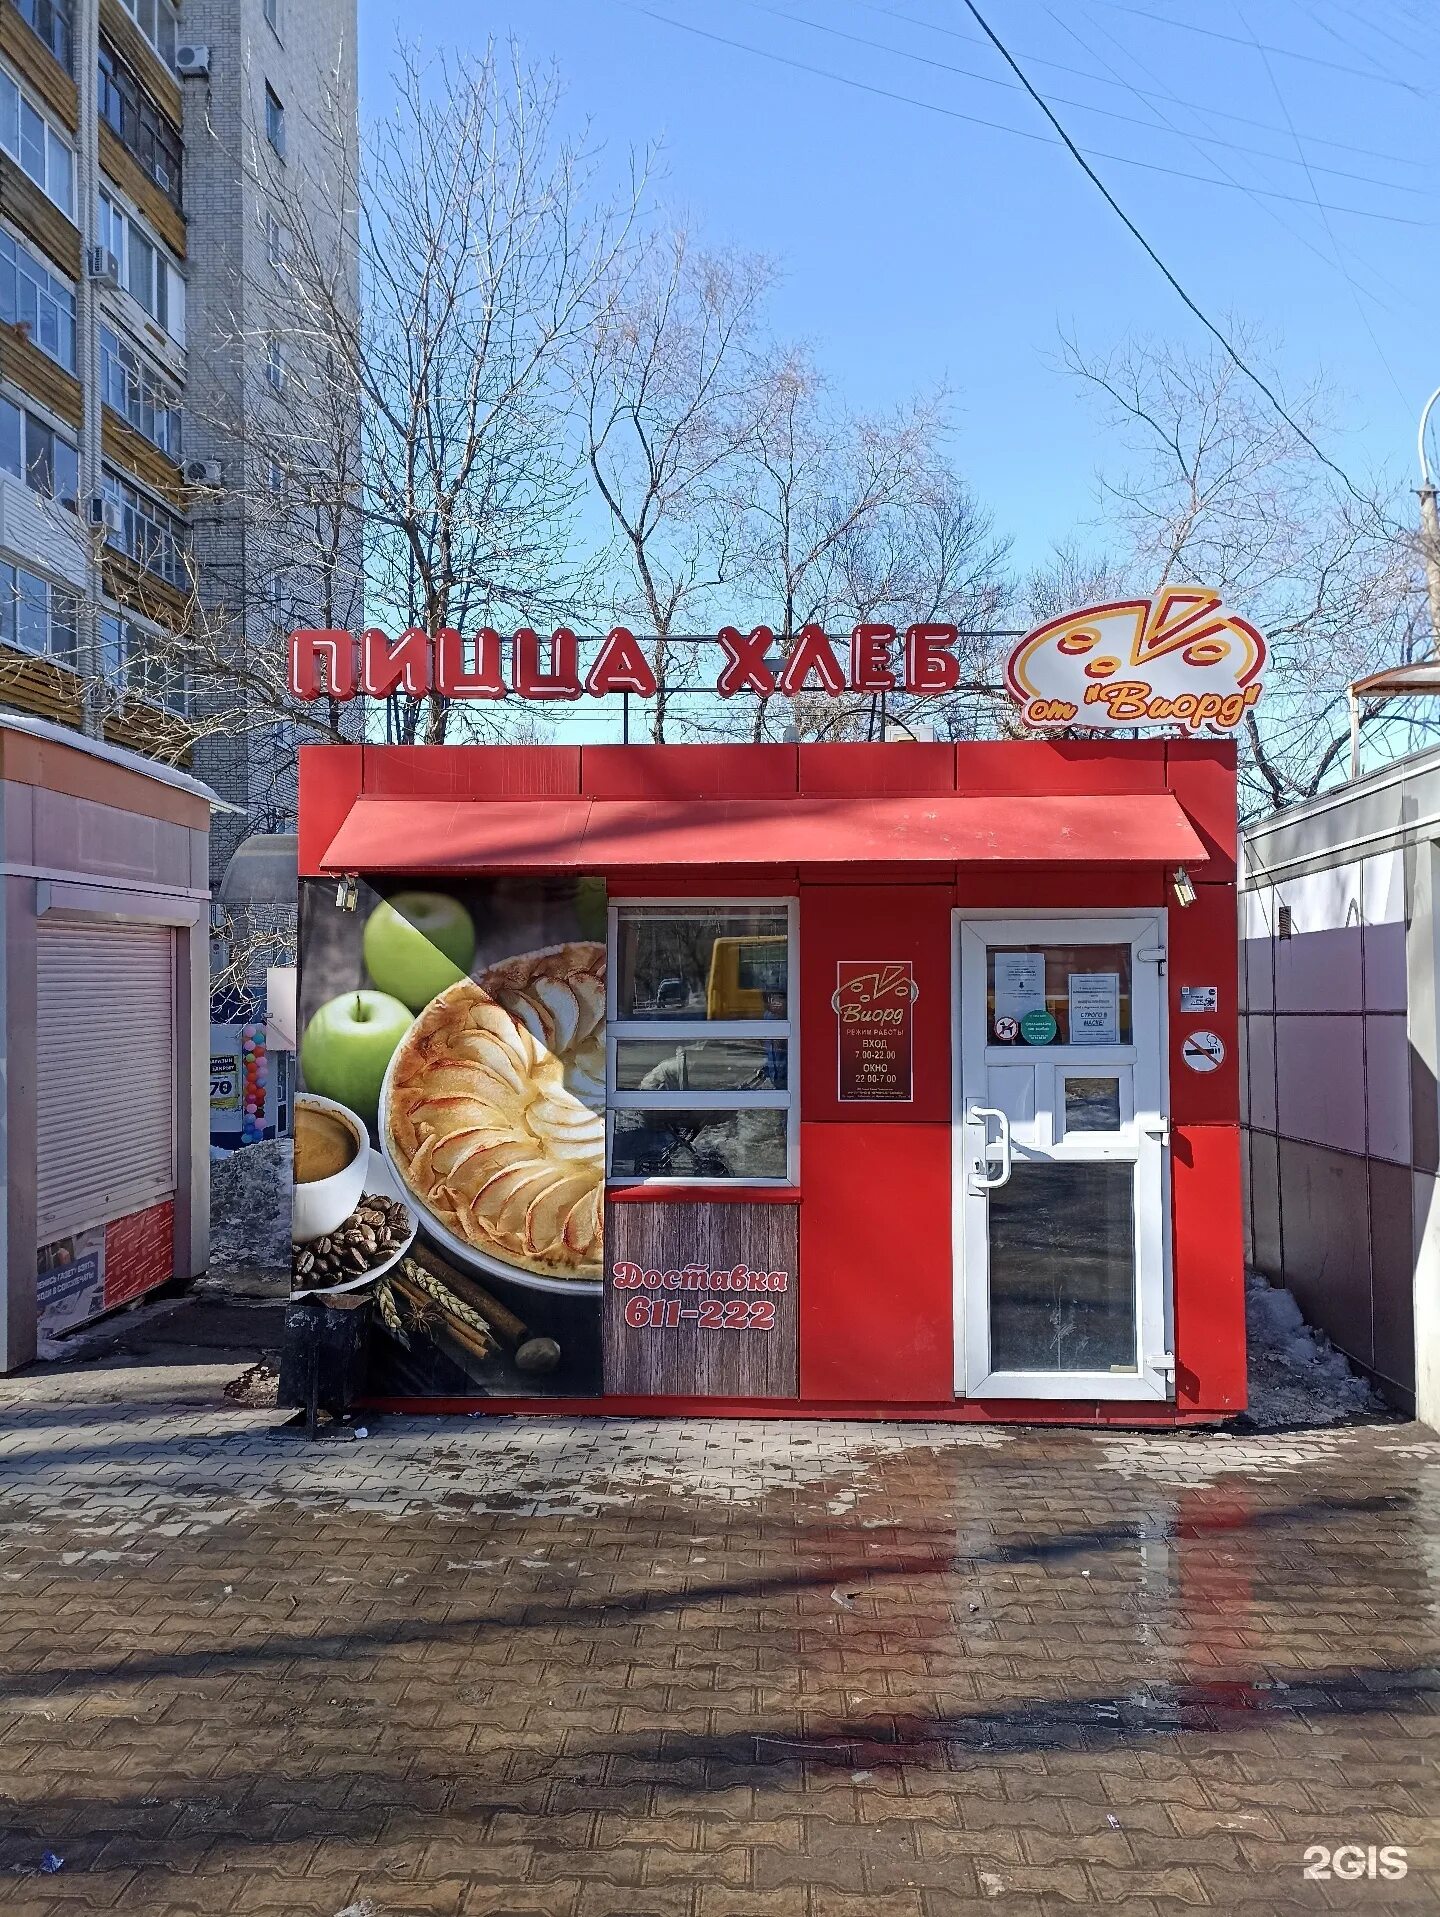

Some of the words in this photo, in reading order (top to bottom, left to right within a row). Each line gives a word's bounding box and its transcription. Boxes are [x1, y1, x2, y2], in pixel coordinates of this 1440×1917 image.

[288, 627, 657, 700] ПИЦЦА
[717, 624, 960, 697] ХЛЕБ
[1027, 698, 1078, 721] от
[840, 1003, 904, 1026] Виорд
[862, 1039, 888, 1049] ВХОД
[863, 1063, 888, 1073] ОКНО
[613, 1262, 788, 1292] Доставка
[625, 1295, 775, 1330] 611-222
